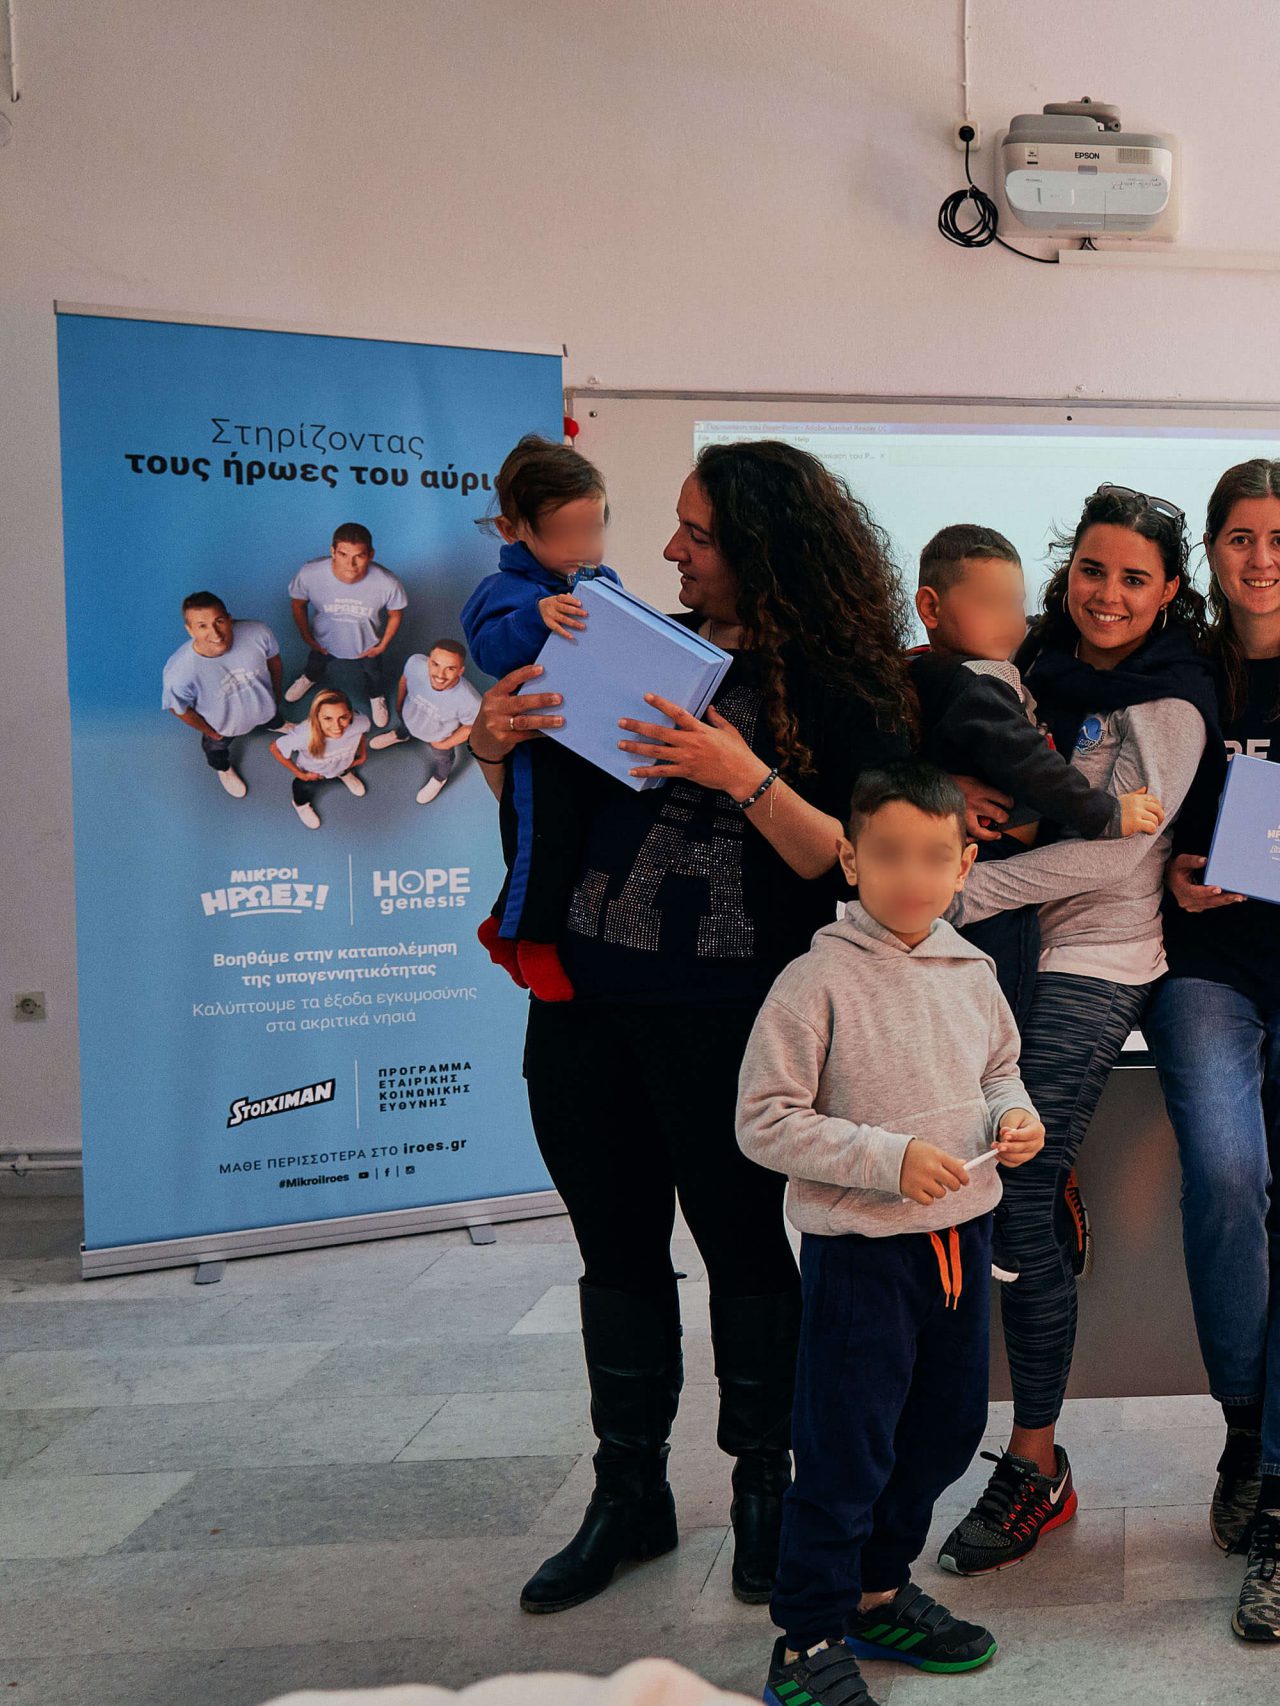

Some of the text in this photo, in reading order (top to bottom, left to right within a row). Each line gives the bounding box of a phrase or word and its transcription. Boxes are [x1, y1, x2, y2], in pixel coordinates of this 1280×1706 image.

[1074, 152, 1100, 160] EPSON
[210, 418, 424, 460] Στηρίζοντας
[125, 454, 211, 482] τους
[223, 451, 339, 488] ήρωες
[350, 465, 409, 486] του
[230, 868, 299, 883] ΜΙΚΡΟΙ
[372, 867, 471, 897] HOPE
[201, 883, 330, 916] ΗΡΩΕΣ!
[380, 893, 466, 915] genesis
[213, 941, 458, 968] Βοηθάμε στην καταπολέμηση
[242, 963, 437, 988] της υπογεννητικότητας
[193, 986, 478, 1016] Καλύπτουμε τα έξοδα εγκυμοσύνης
[266, 1009, 417, 1033] στα ακριτικά νησιά
[378, 1062, 472, 1077] ΠΡΟΓΡΑΜΜΑ
[379, 1074, 458, 1089] ΕΤΑΙΡΙΚΗΣ
[379, 1084, 471, 1101] ΚΟΙΝΩΝΙΚΗΣ
[380, 1098, 448, 1112] ΕΥΘΥΝΗΣ
[219, 1139, 467, 1174] ΜΑΘΕ ΠΕΡΙΣΣΟΤΕΡΑ ΣΤΟ iroes.gr
